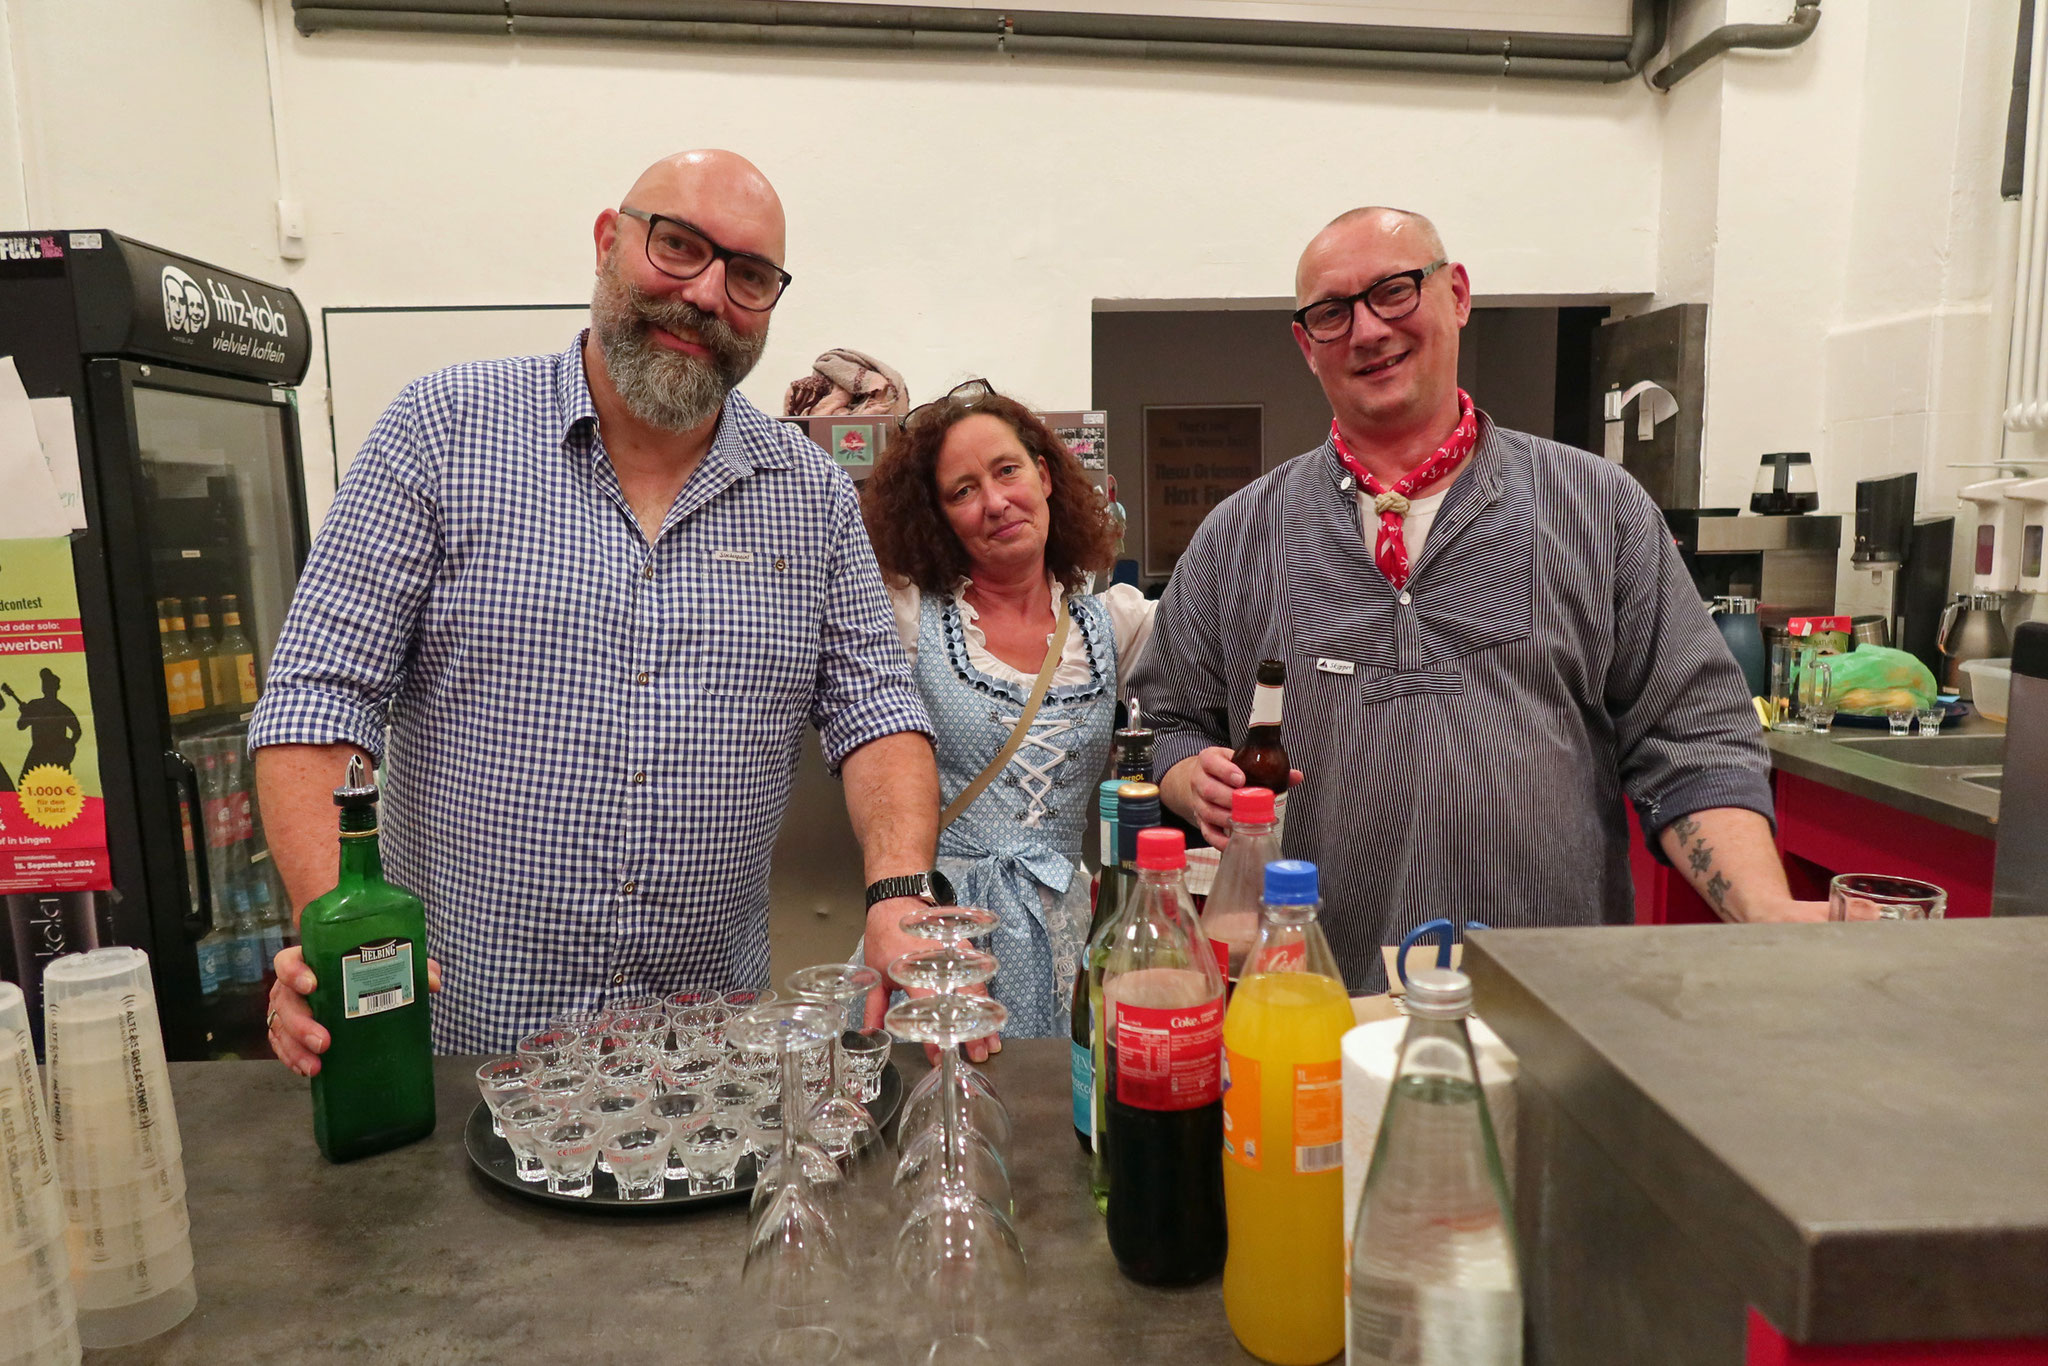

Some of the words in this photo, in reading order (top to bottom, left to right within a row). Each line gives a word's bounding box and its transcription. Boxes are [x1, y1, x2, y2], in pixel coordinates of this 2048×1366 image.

[206, 278, 288, 338] fritz-kola
[212, 331, 252, 356] vielviel
[251, 338, 286, 364] koffein
[12, 623, 36, 631] oder
[37, 622, 60, 630] solo:
[27, 786, 63, 796] 1.000
[66, 786, 77, 796] €
[7, 836, 17, 844] in
[19, 836, 51, 845] Lingen
[27, 861, 73, 870] September
[361, 944, 396, 963] HELBING
[1170, 1016, 1198, 1029] Coke
